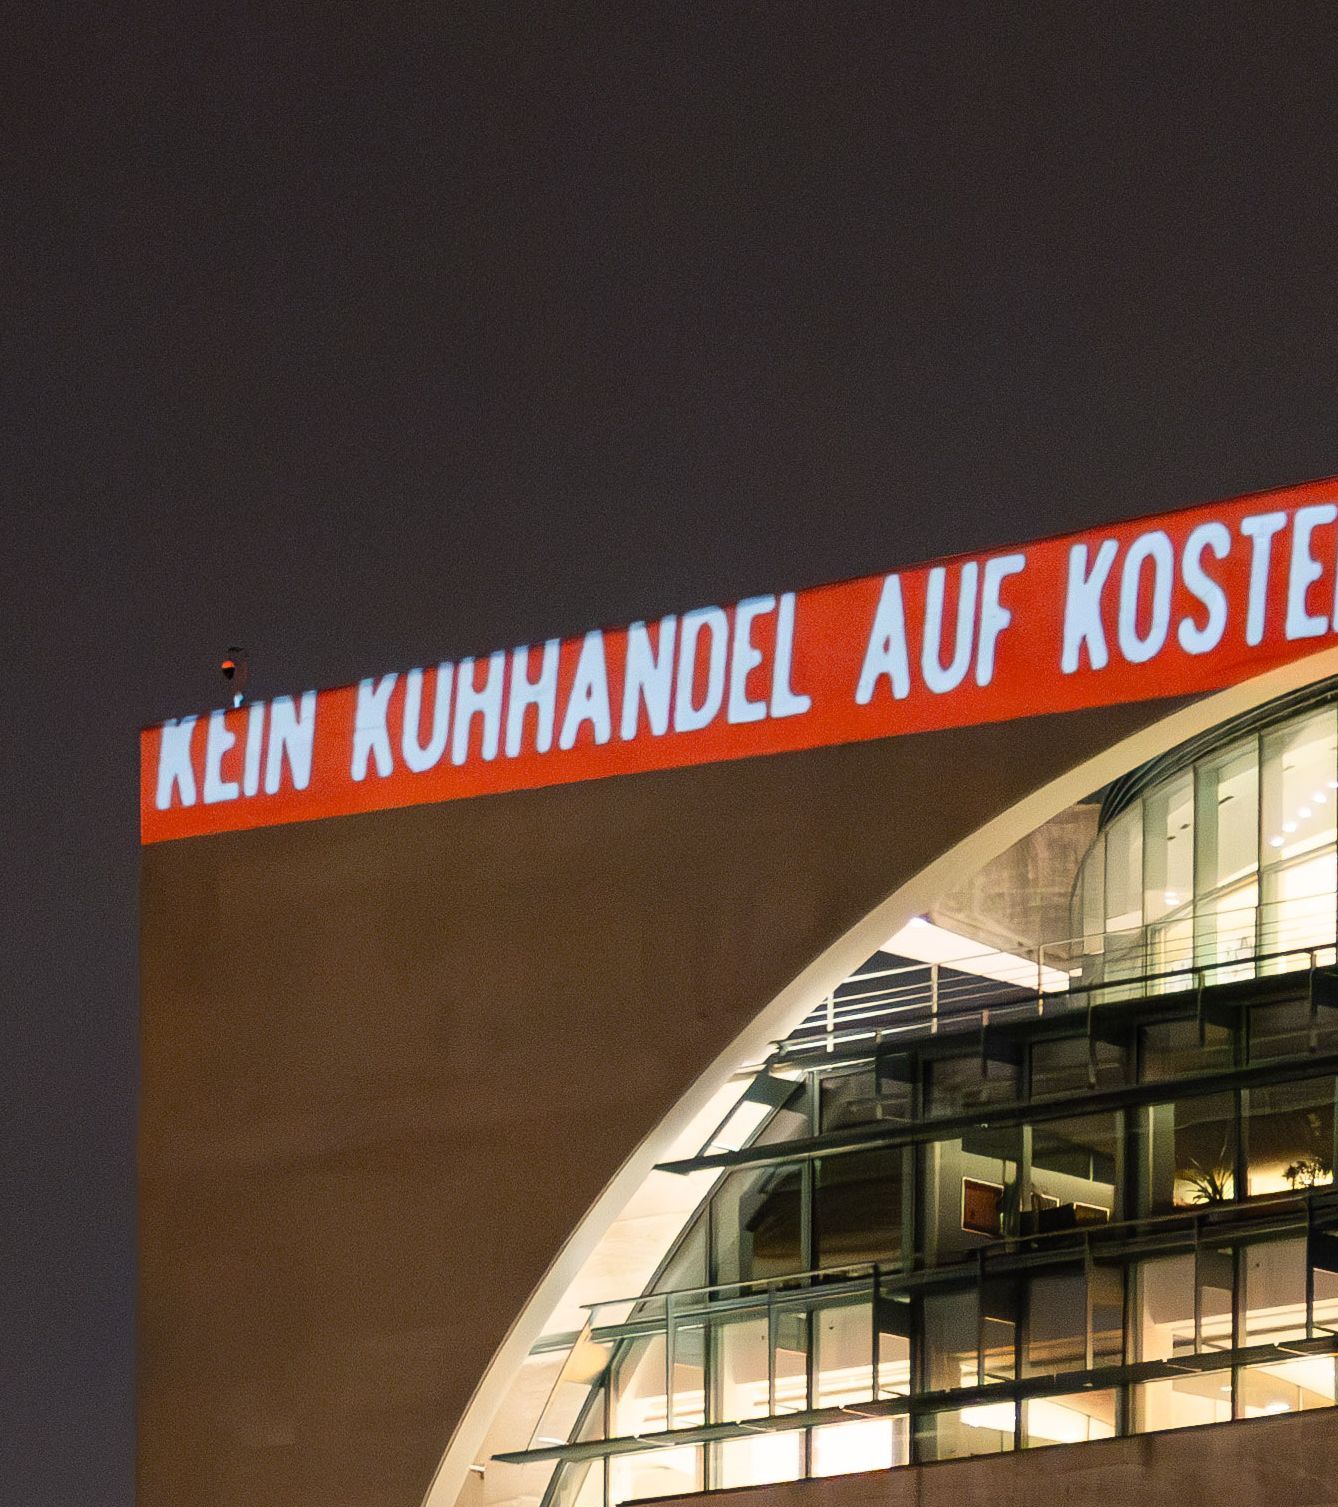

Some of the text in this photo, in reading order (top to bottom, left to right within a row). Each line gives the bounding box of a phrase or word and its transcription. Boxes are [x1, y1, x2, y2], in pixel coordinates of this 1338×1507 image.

[155, 690, 316, 810] KEIN
[351, 592, 812, 782] KUHHANDEL
[855, 552, 1027, 706] AUF
